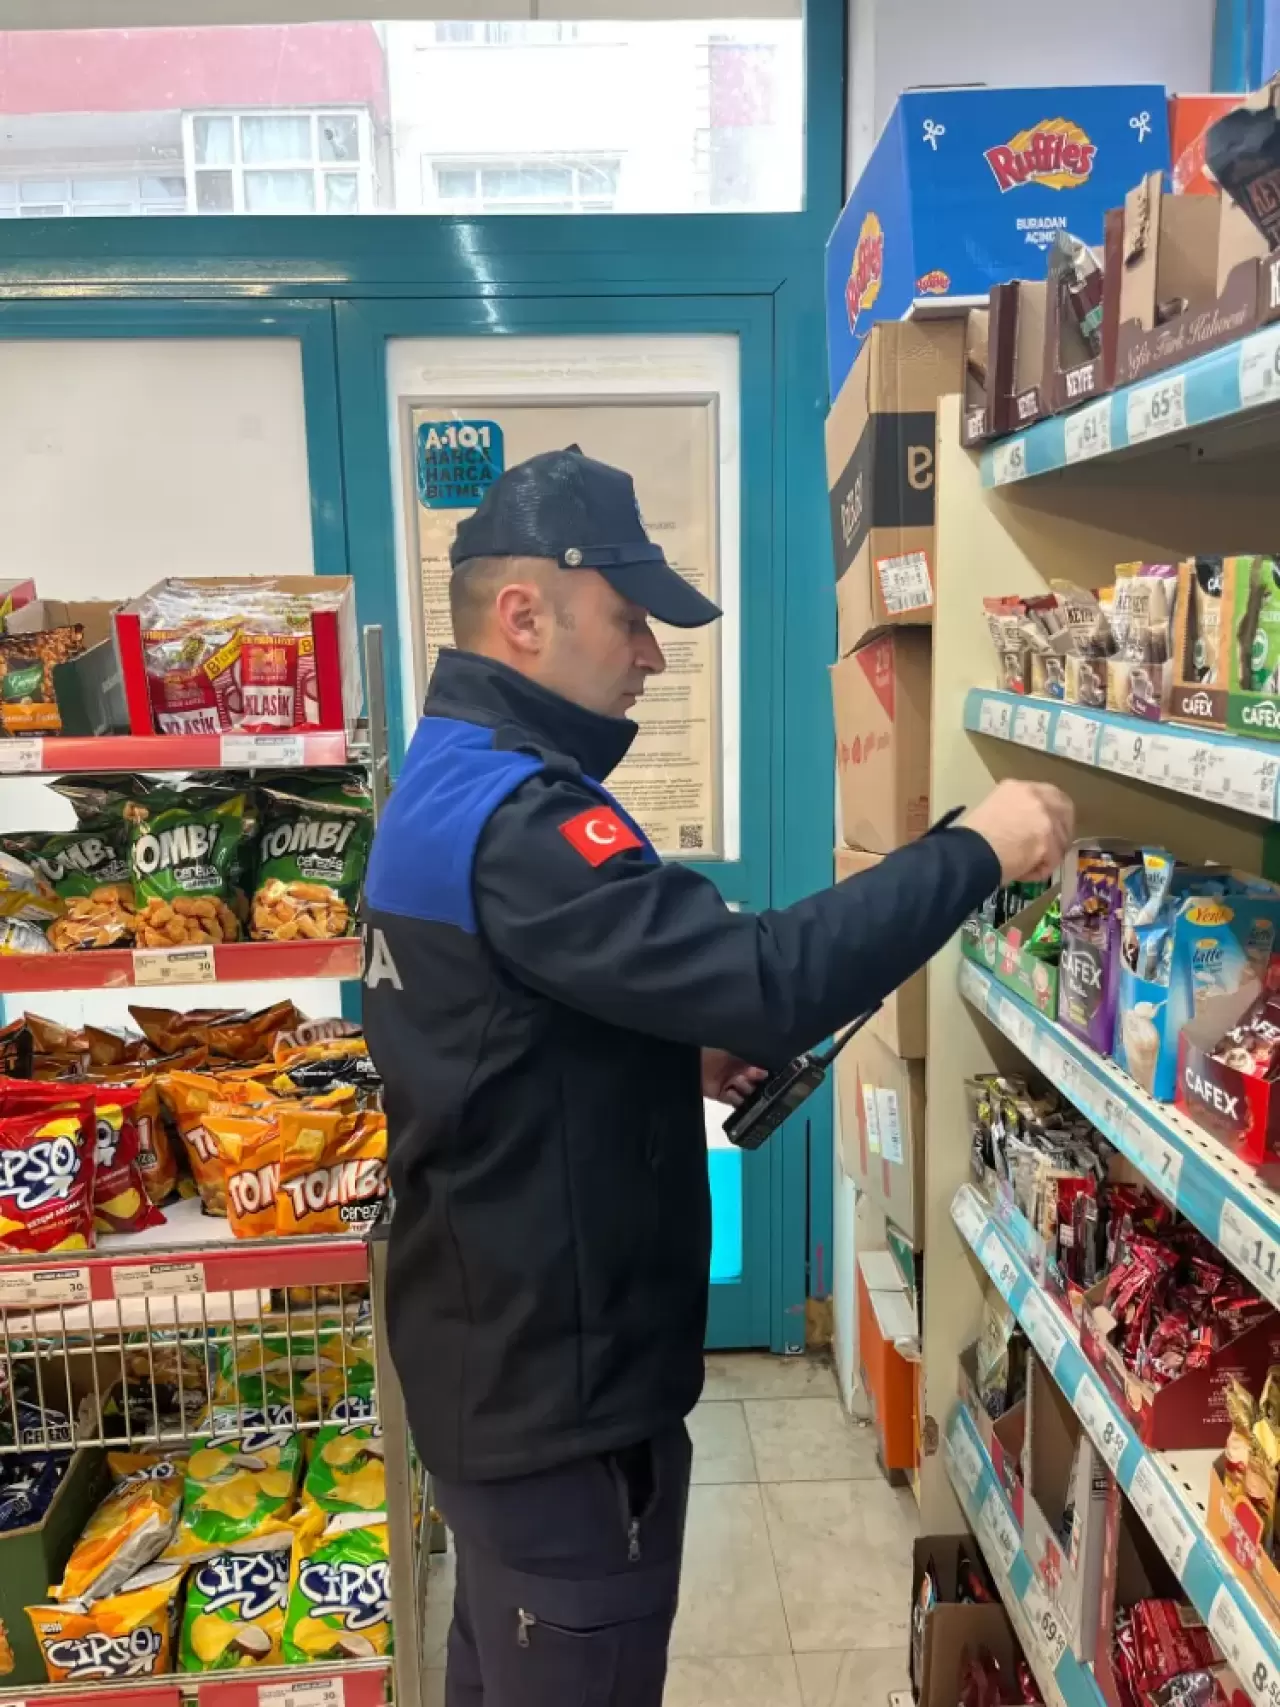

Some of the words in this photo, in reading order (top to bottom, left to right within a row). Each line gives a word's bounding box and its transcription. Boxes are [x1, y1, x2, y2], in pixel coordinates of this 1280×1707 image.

[982, 131, 1097, 193] Ruffles
[1016, 217, 1067, 231] BURADAN
[1150, 388, 1171, 420] 65
[1083, 417, 1098, 442] 61
[426, 465, 493, 481] HARCA
[1181, 692, 1214, 718] CAFEX
[1061, 949, 1104, 990] CAFEX
[1185, 1066, 1239, 1121] CAFEX
[0, 1138, 76, 1188] PSO
